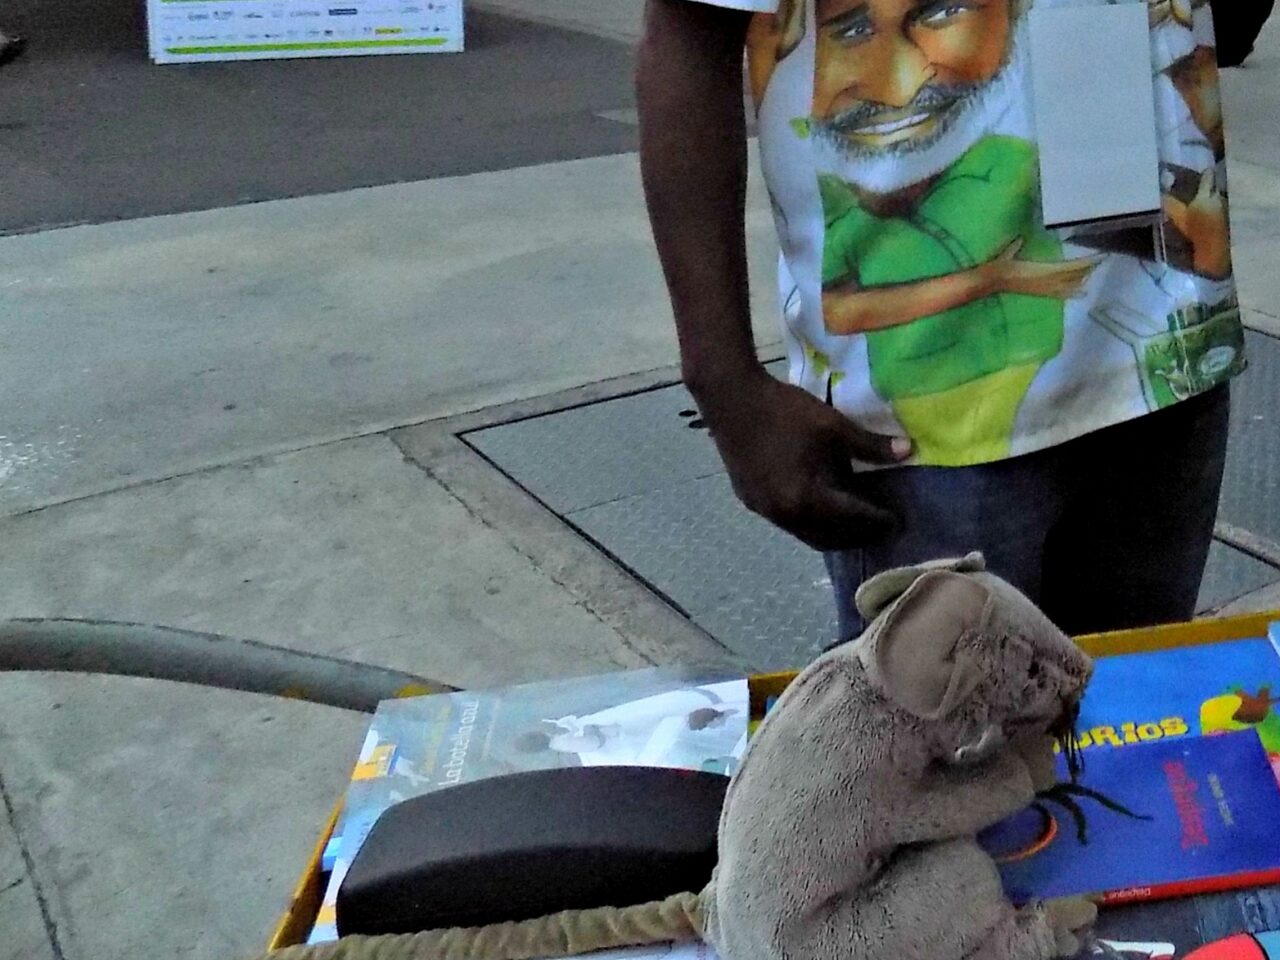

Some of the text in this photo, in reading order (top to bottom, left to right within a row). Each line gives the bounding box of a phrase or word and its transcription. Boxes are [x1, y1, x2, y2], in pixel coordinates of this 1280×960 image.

[461, 700, 480, 725] azul
[442, 725, 474, 769] botella
[438, 770, 462, 786] La
